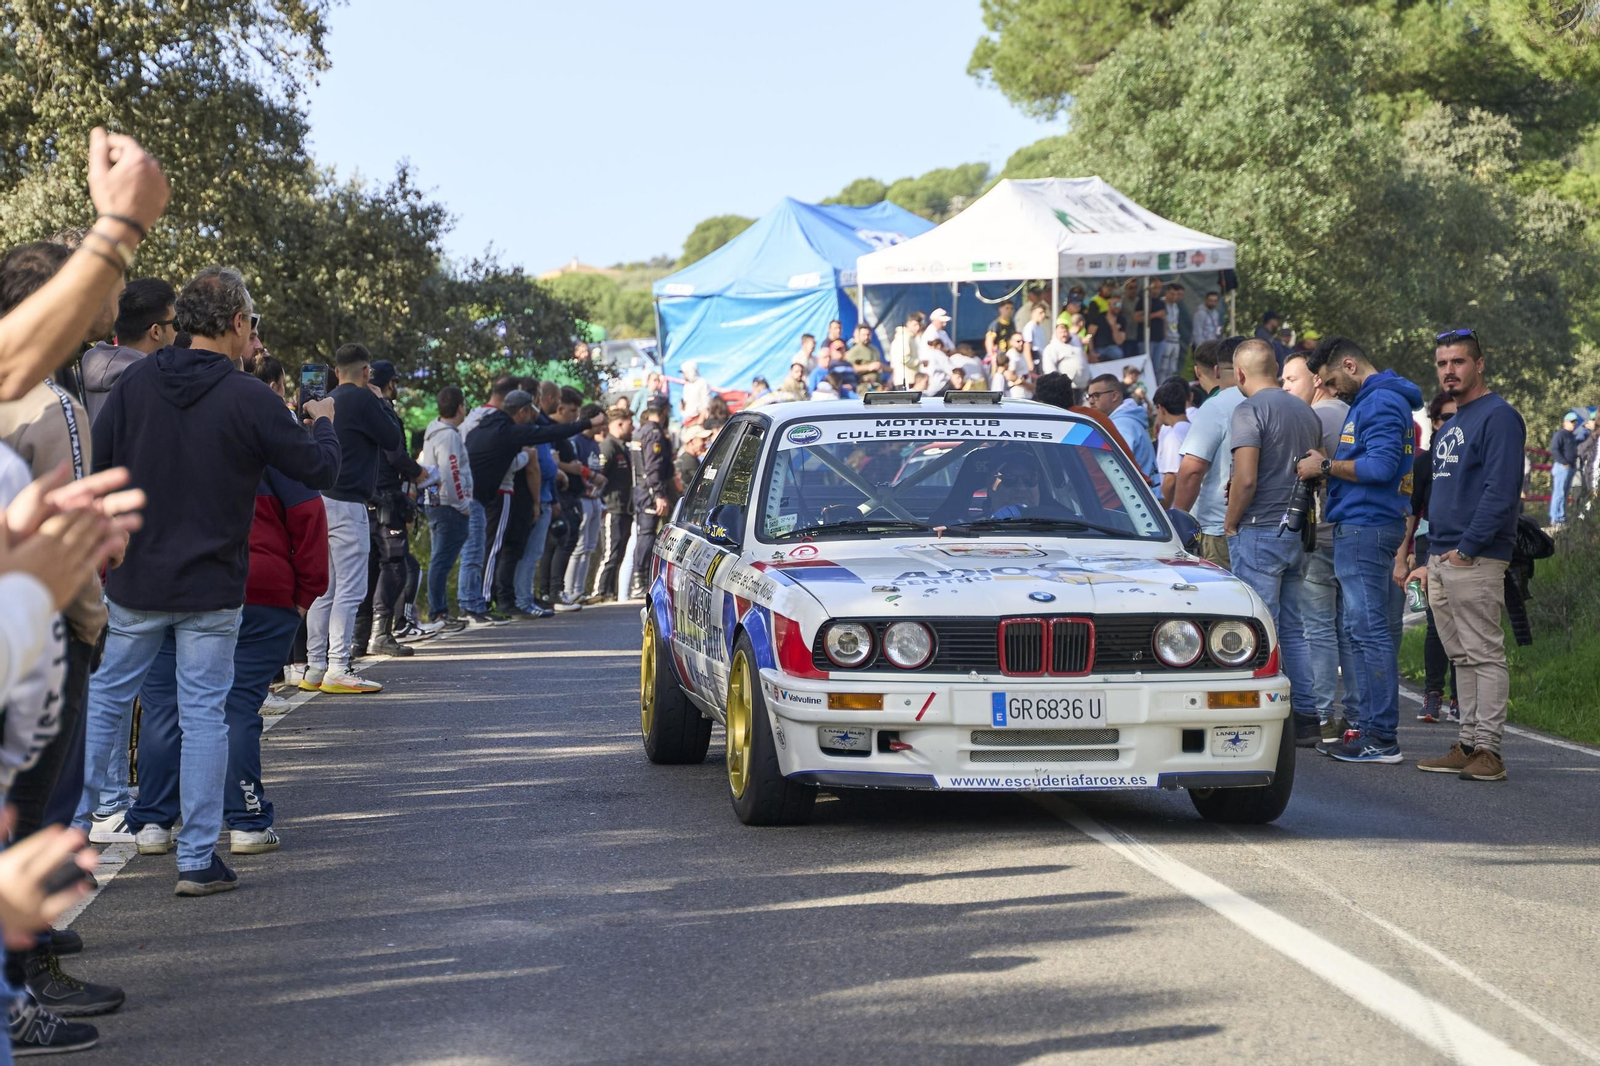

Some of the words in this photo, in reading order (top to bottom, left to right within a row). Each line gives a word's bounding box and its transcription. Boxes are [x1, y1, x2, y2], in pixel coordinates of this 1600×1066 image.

[876, 419, 1001, 427] MOTORCLUB
[836, 429, 1053, 440] CULEBRIN-PALLARES
[788, 693, 822, 704] Valvoline
[1009, 698, 1033, 720] GR
[1036, 698, 1084, 720] 6836
[1089, 698, 1101, 719] U
[996, 713, 1004, 721] E
